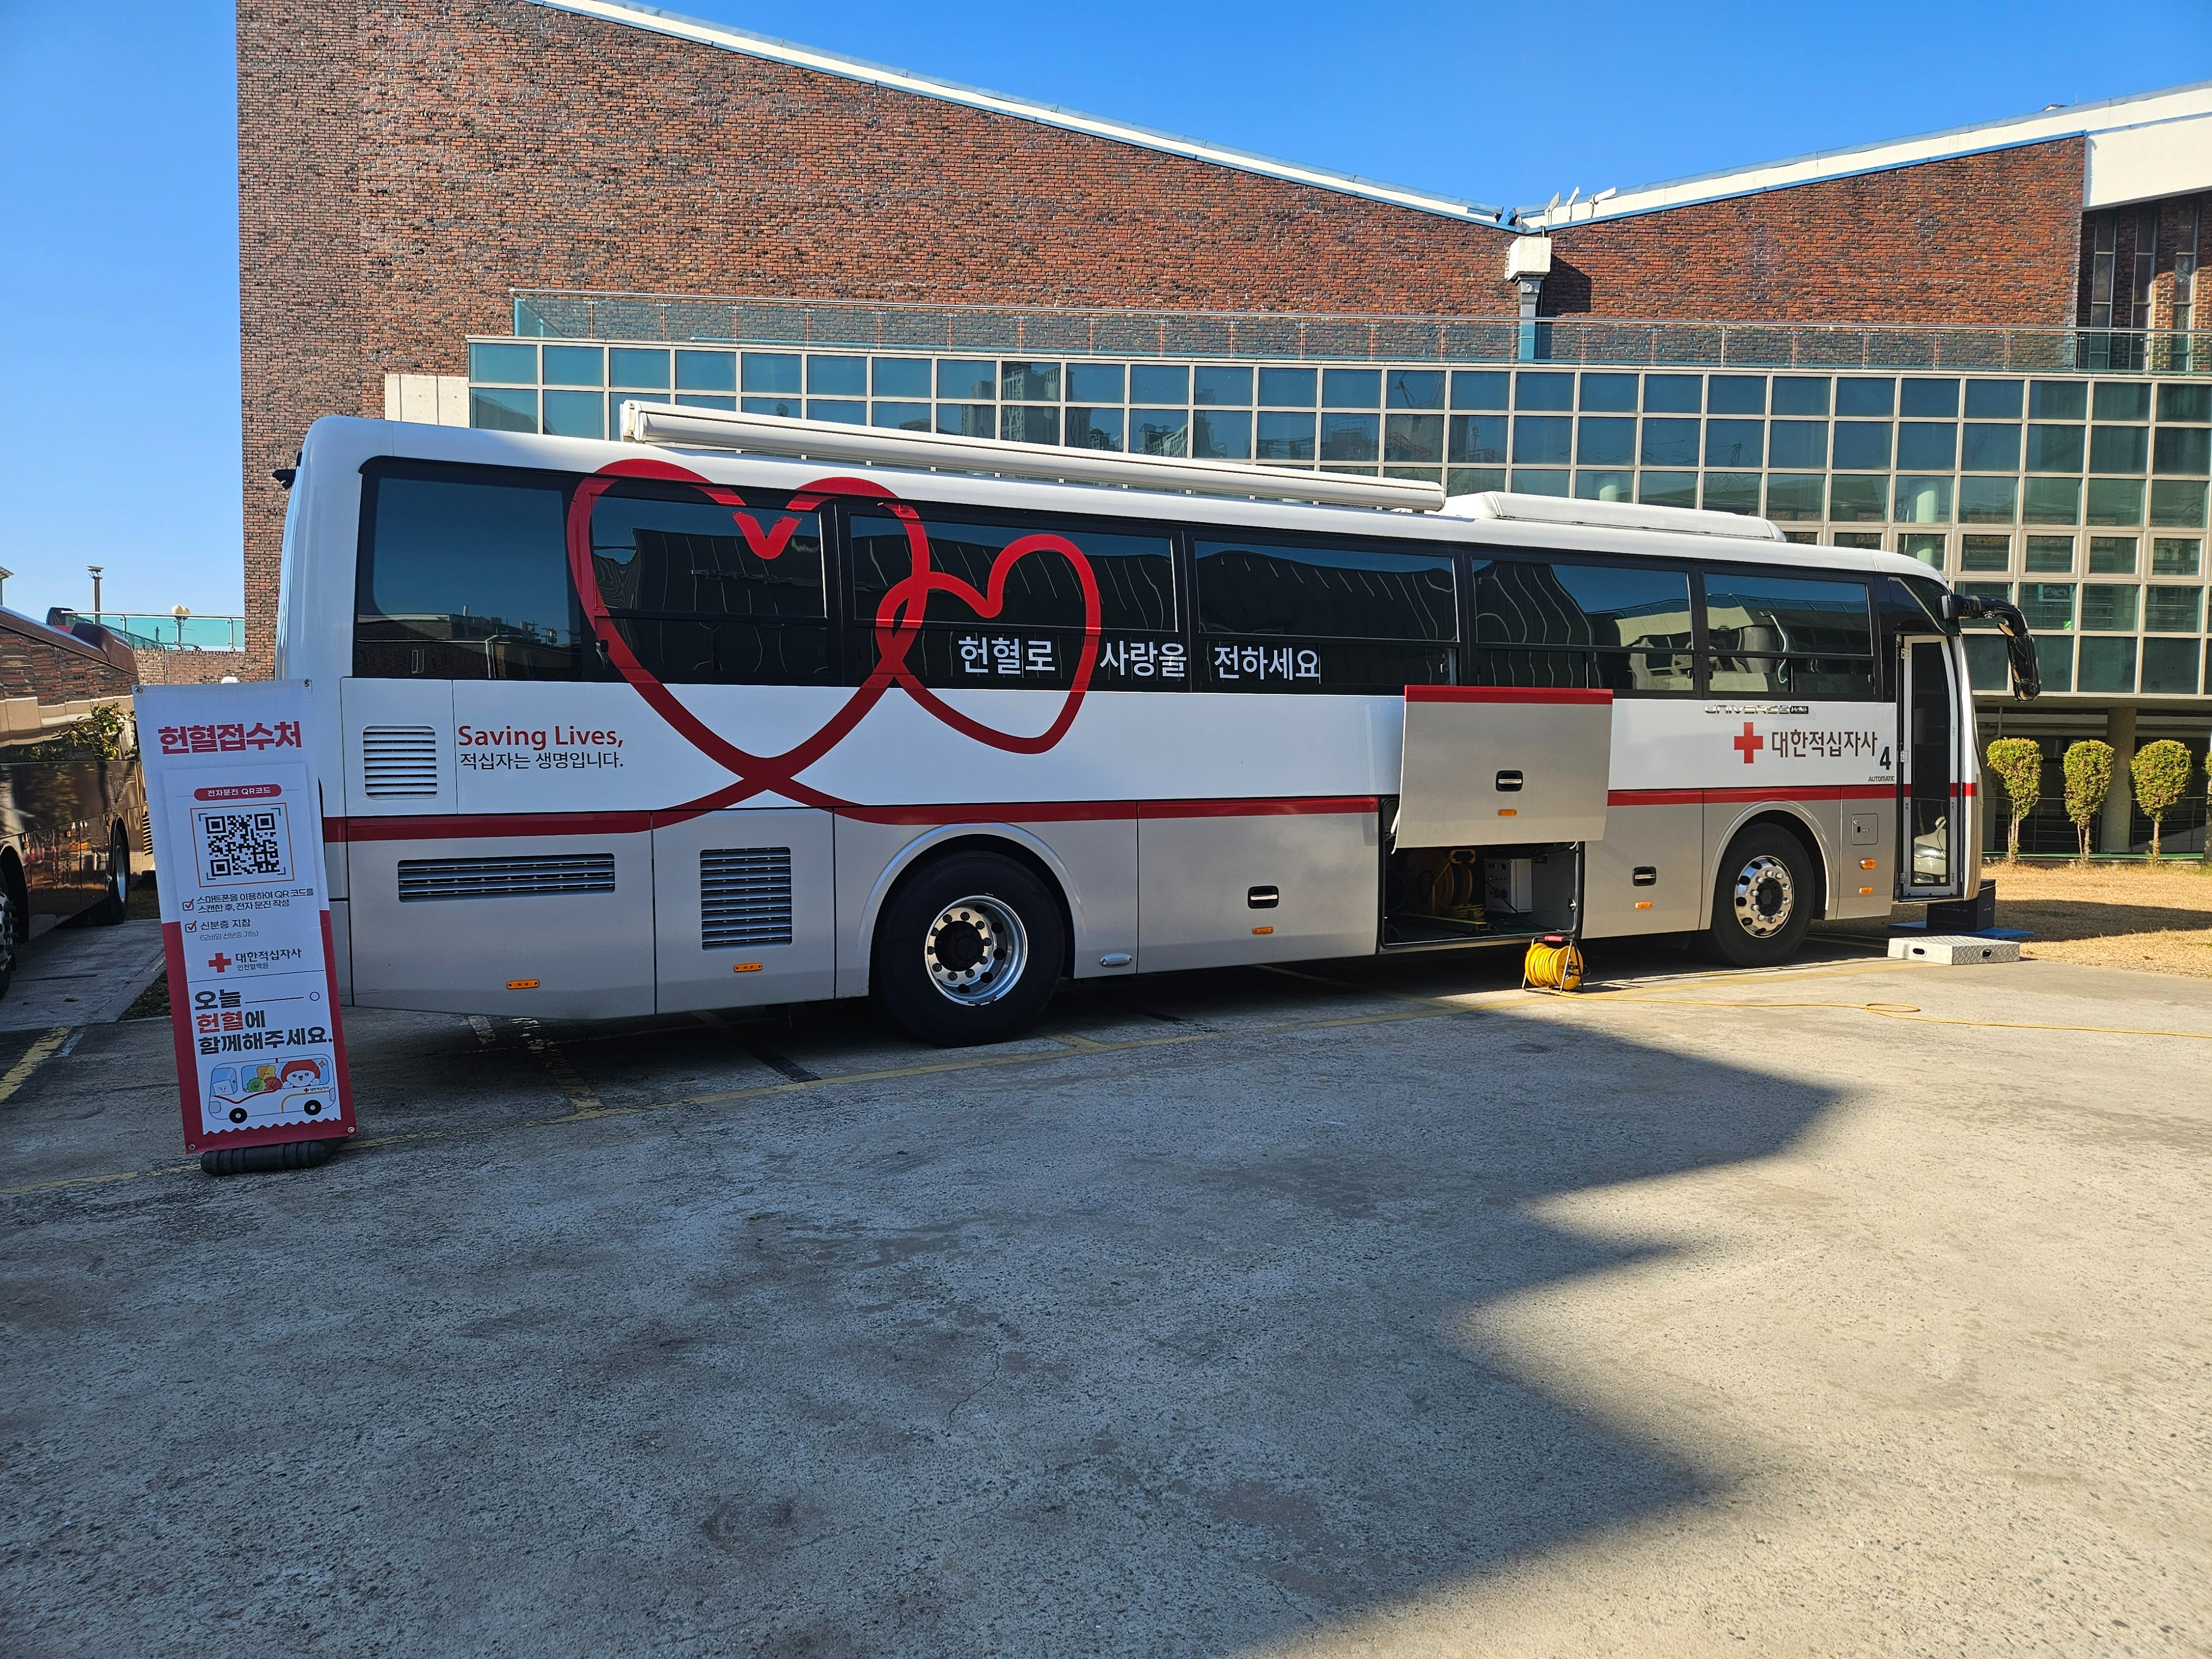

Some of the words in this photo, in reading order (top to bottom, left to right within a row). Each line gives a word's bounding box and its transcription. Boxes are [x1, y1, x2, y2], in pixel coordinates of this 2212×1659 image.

[958, 636, 1056, 675] 헌혈로
[1099, 640, 1187, 677] 사랑을
[1214, 646, 1321, 681] 전하세요
[158, 721, 302, 755] 헌혈접수처
[458, 726, 546, 750] Saving
[555, 726, 623, 748] Lives,
[1772, 729, 1877, 758] 대한적십자사
[460, 753, 531, 770] 적십자는
[535, 752, 624, 769] 생명입니다.
[1879, 746, 1891, 770] 4
[196, 894, 238, 904] 스마트폰을
[239, 891, 273, 901] 이용하여
[274, 890, 289, 899] QR
[290, 888, 314, 897] 코드를
[198, 904, 223, 913] 스캔한
[225, 902, 236, 912] 후,
[236, 901, 253, 910] 전자
[254, 900, 271, 909] 문진
[273, 899, 290, 907] 작성
[200, 920, 229, 930] 신분증
[232, 919, 251, 928] 지참
[200, 933, 222, 941] (모바일
[236, 948, 302, 963] 대한적십자사
[237, 962, 269, 971] 인천혈액원
[195, 989, 241, 1010] 오늘
[196, 1010, 265, 1034] 헌혈에
[198, 1026, 333, 1055] 함께해주세요.
